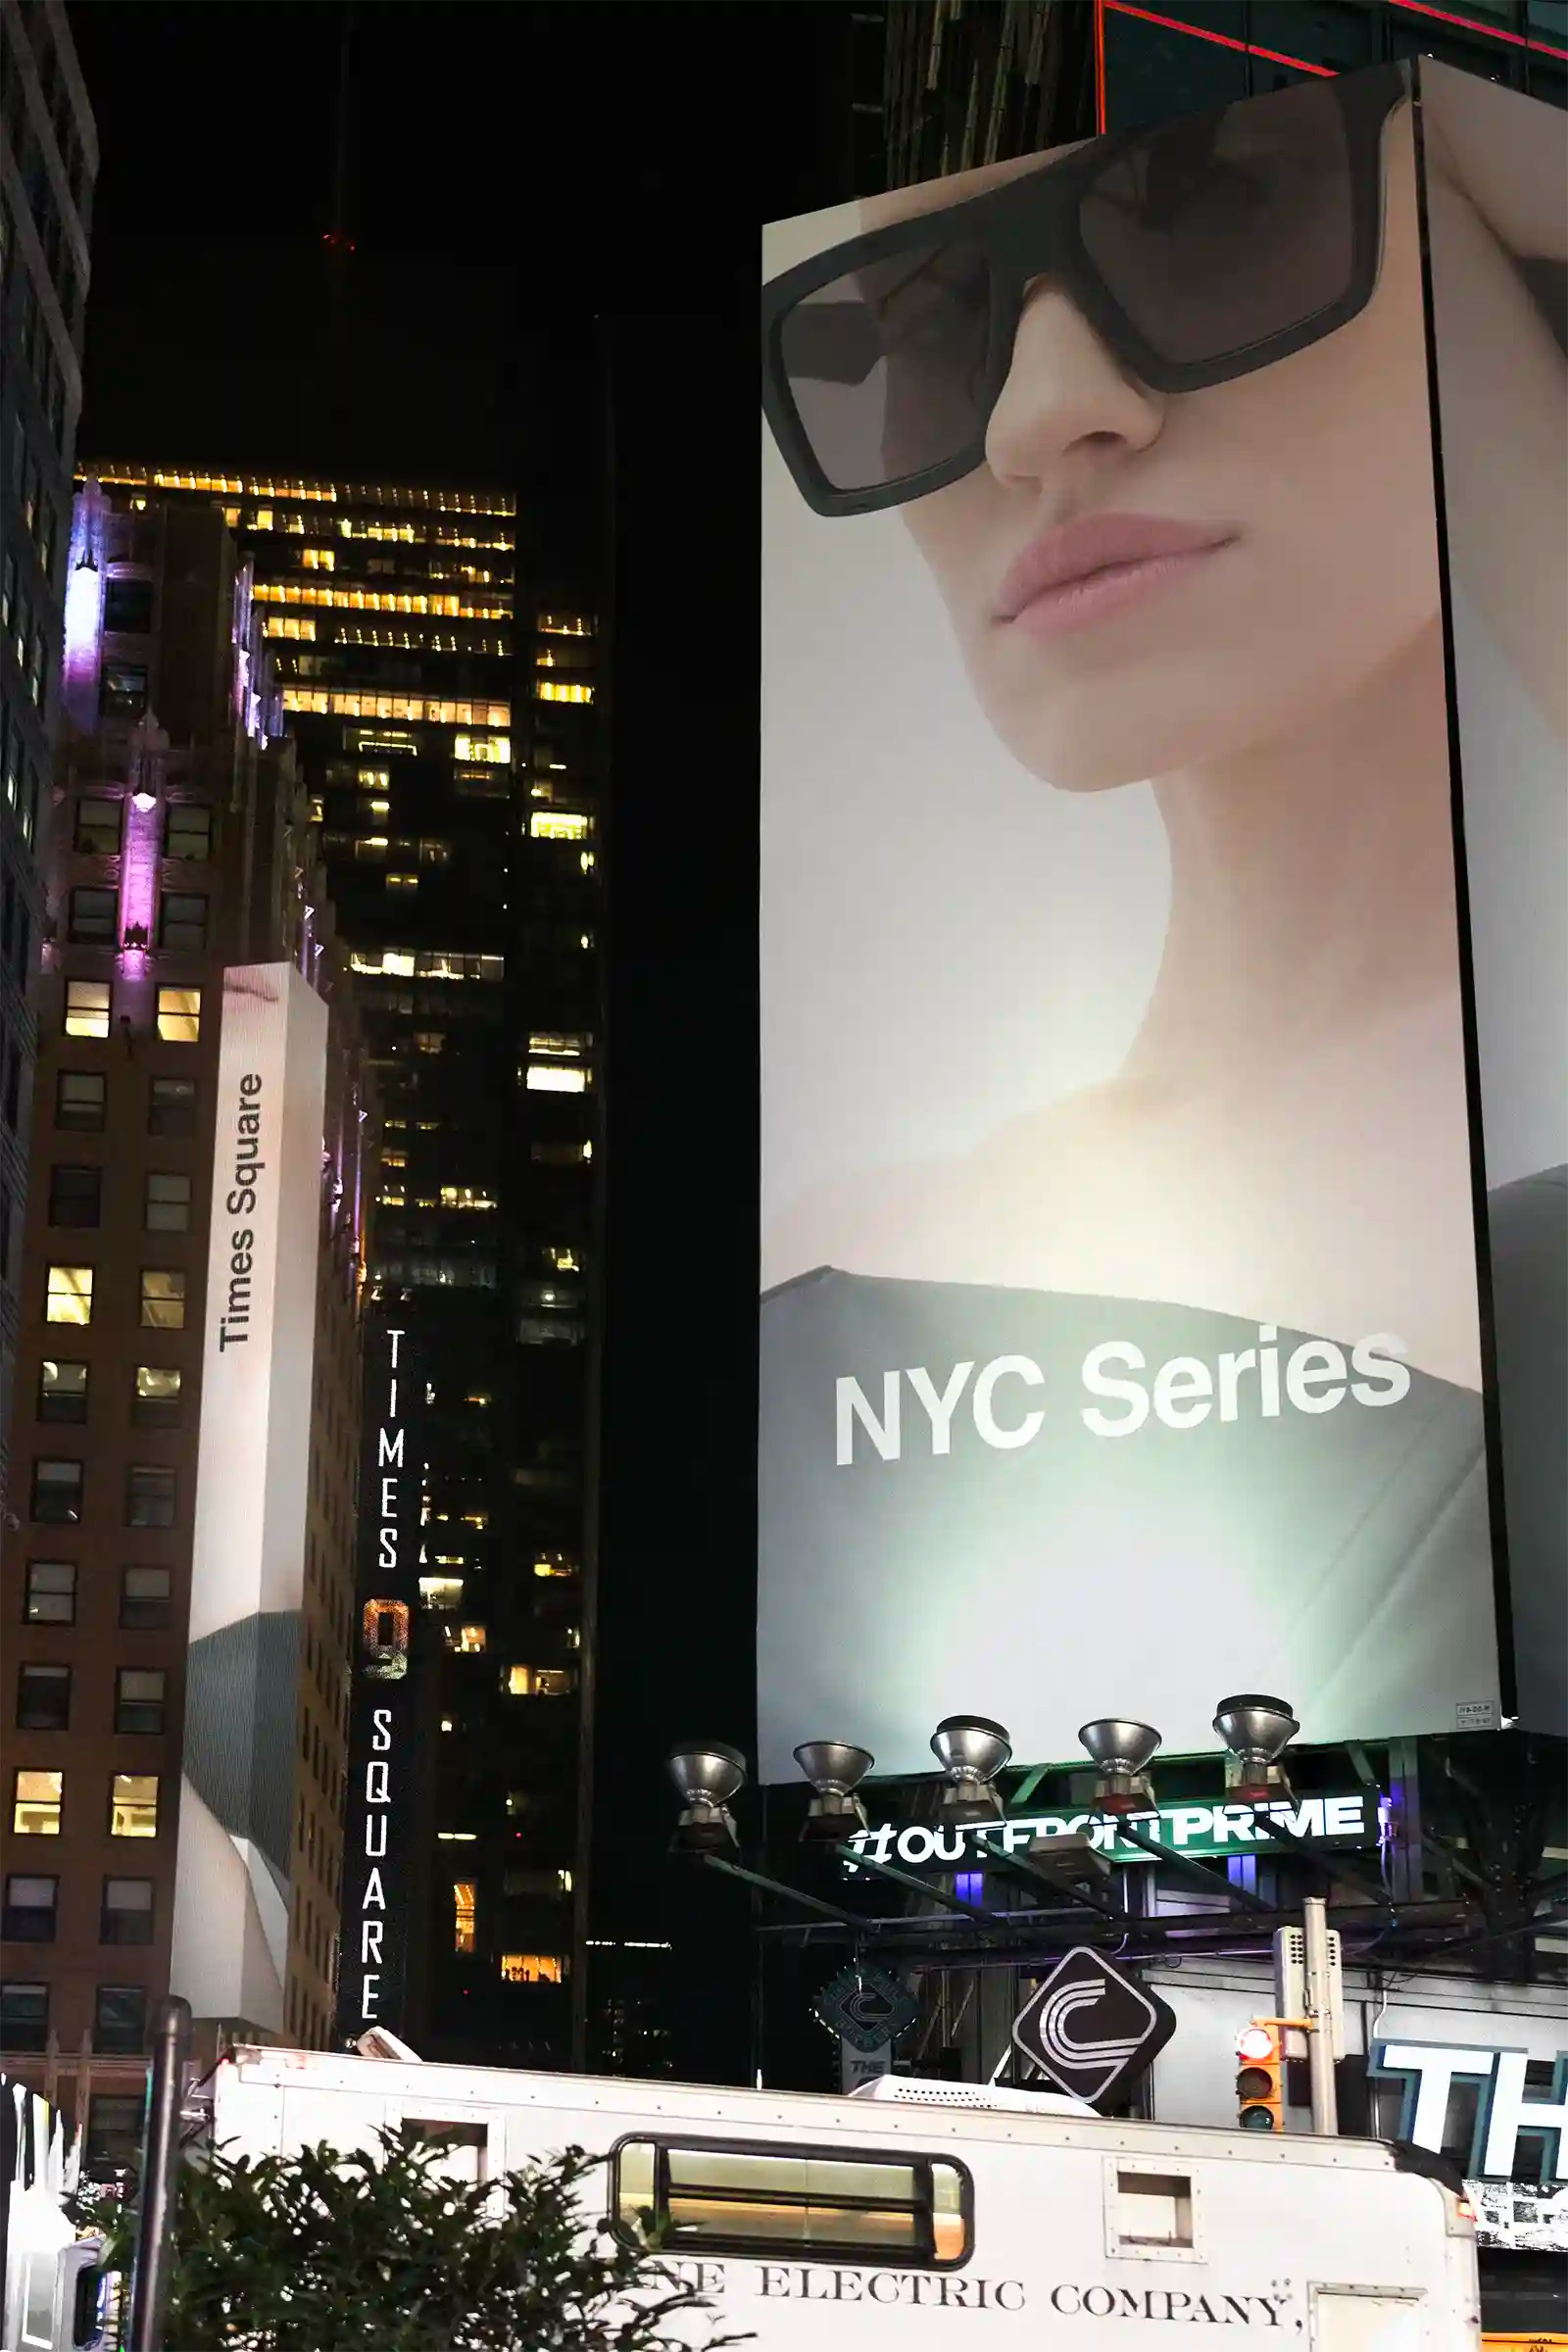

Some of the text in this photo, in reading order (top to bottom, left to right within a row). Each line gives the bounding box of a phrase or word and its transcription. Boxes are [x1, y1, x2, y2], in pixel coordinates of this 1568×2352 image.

[219, 1073, 266, 1352] Times Square
[377, 1329, 406, 1569] TIMES
[836, 1325, 1411, 1466] NYC Series
[361, 1709, 392, 2019] SQUARE
[850, 2060, 886, 2076] THE
[760, 2265, 1027, 2312] ELECTRIC
[1051, 2284, 1304, 2333] COMPANY,
